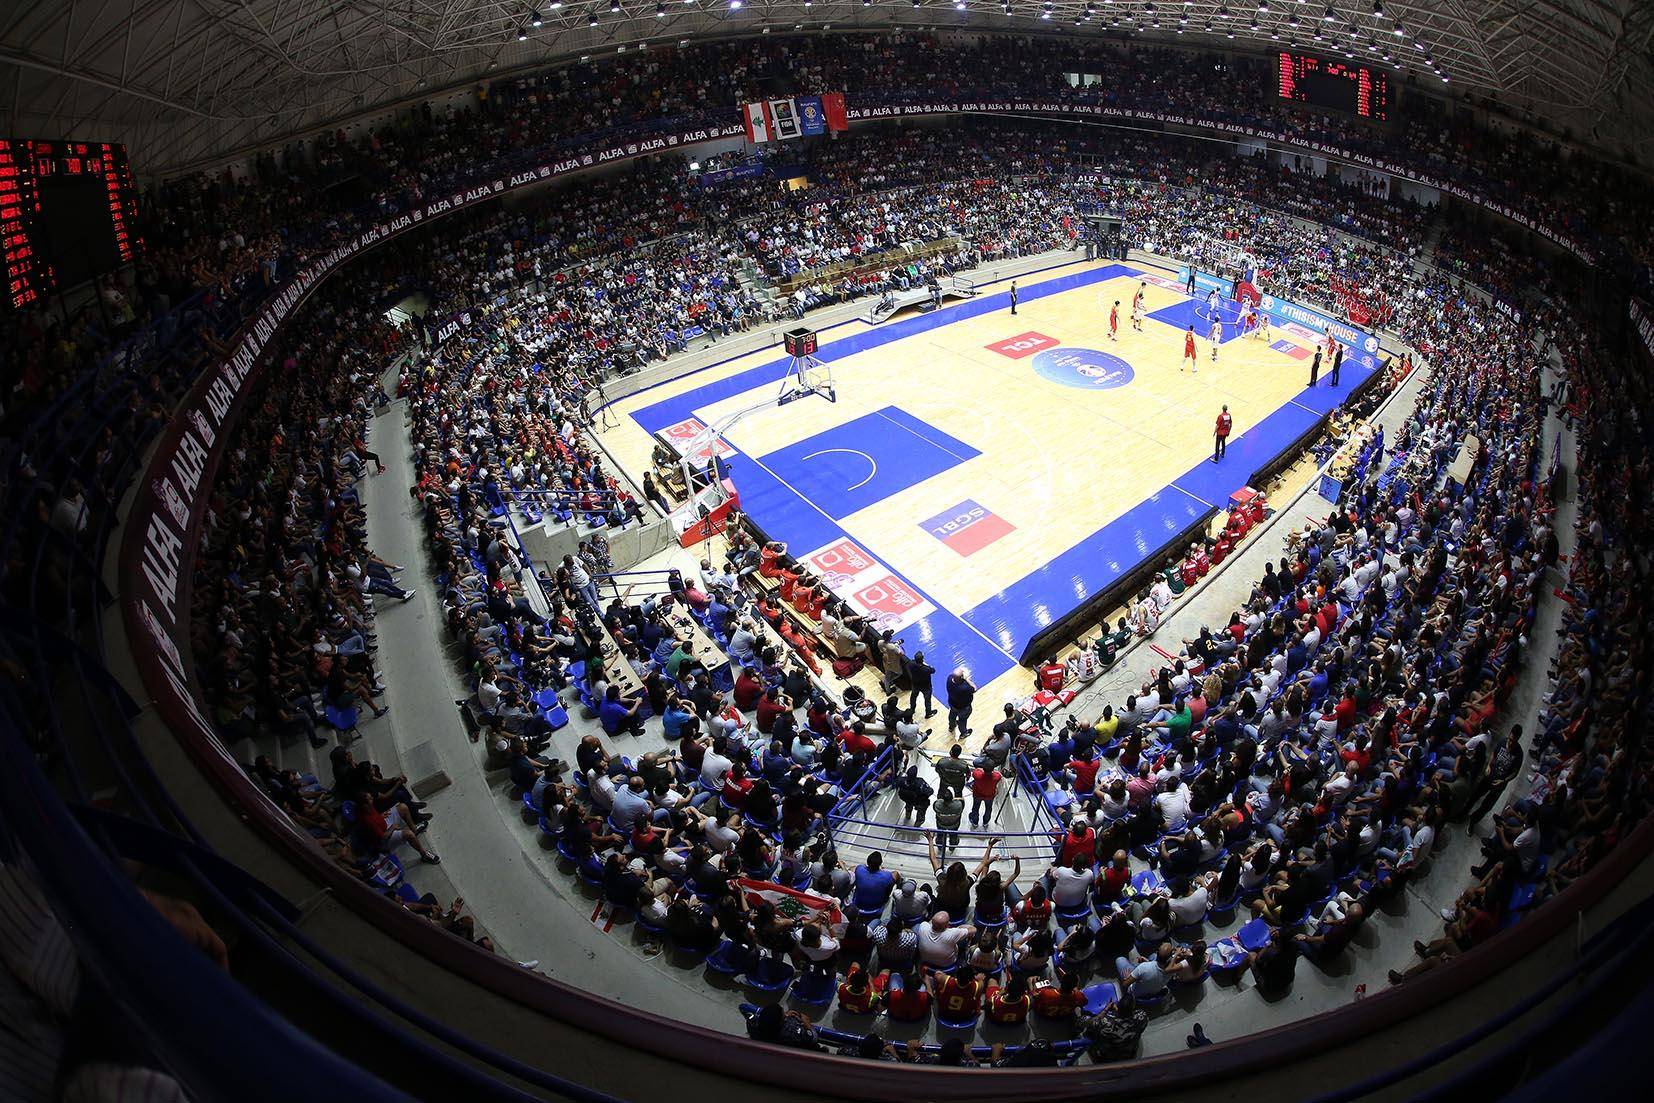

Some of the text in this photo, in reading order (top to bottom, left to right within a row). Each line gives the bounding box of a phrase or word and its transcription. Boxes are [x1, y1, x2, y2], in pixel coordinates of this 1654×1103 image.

[1495, 300, 1512, 316] ALFA
[438, 320, 460, 344] ALFA
[1281, 305, 1358, 343] #THISISMYHOUSE
[801, 334, 816, 342] 7:00
[804, 342, 814, 354] 13
[142, 513, 182, 624] ALFA
[171, 430, 208, 503] ALFA
[205, 376, 234, 426] ALFA
[362, 230, 380, 247] ALFA
[391, 216, 412, 232] ALFA
[428, 200, 450, 216] ALFA
[466, 186, 492, 202] ALFA
[510, 171, 537, 188] ALFA
[554, 159, 580, 174] ALFA
[599, 148, 624, 162] ALFA
[640, 138, 665, 152] ALFA
[684, 130, 708, 143] ALFA
[722, 124, 744, 136] ALFA
[846, 110, 861, 119] LFA
[872, 107, 892, 116] ALFA
[904, 105, 923, 114] ALFA
[962, 103, 978, 112] ALFA
[1014, 103, 1031, 112] ALFA
[1042, 104, 1060, 112] ALFA
[1073, 106, 1092, 114] ALFA
[1104, 108, 1122, 116] ALFA
[1136, 111, 1155, 120] ALFA
[1166, 115, 1184, 124] ALFA
[1197, 120, 1215, 128] ALFA
[1226, 124, 1244, 134] ALFA
[1256, 130, 1276, 140] ALFA
[1290, 138, 1310, 148] ALFA
[1321, 144, 1340, 156] ALFA
[1354, 154, 1374, 166] ALFA
[1451, 186, 1471, 200] ALFA
[1484, 200, 1502, 214] ALFA
[1512, 212, 1529, 228] ALFA
[932, 507, 985, 536] SGBL
[948, 996, 964, 1012] 9
